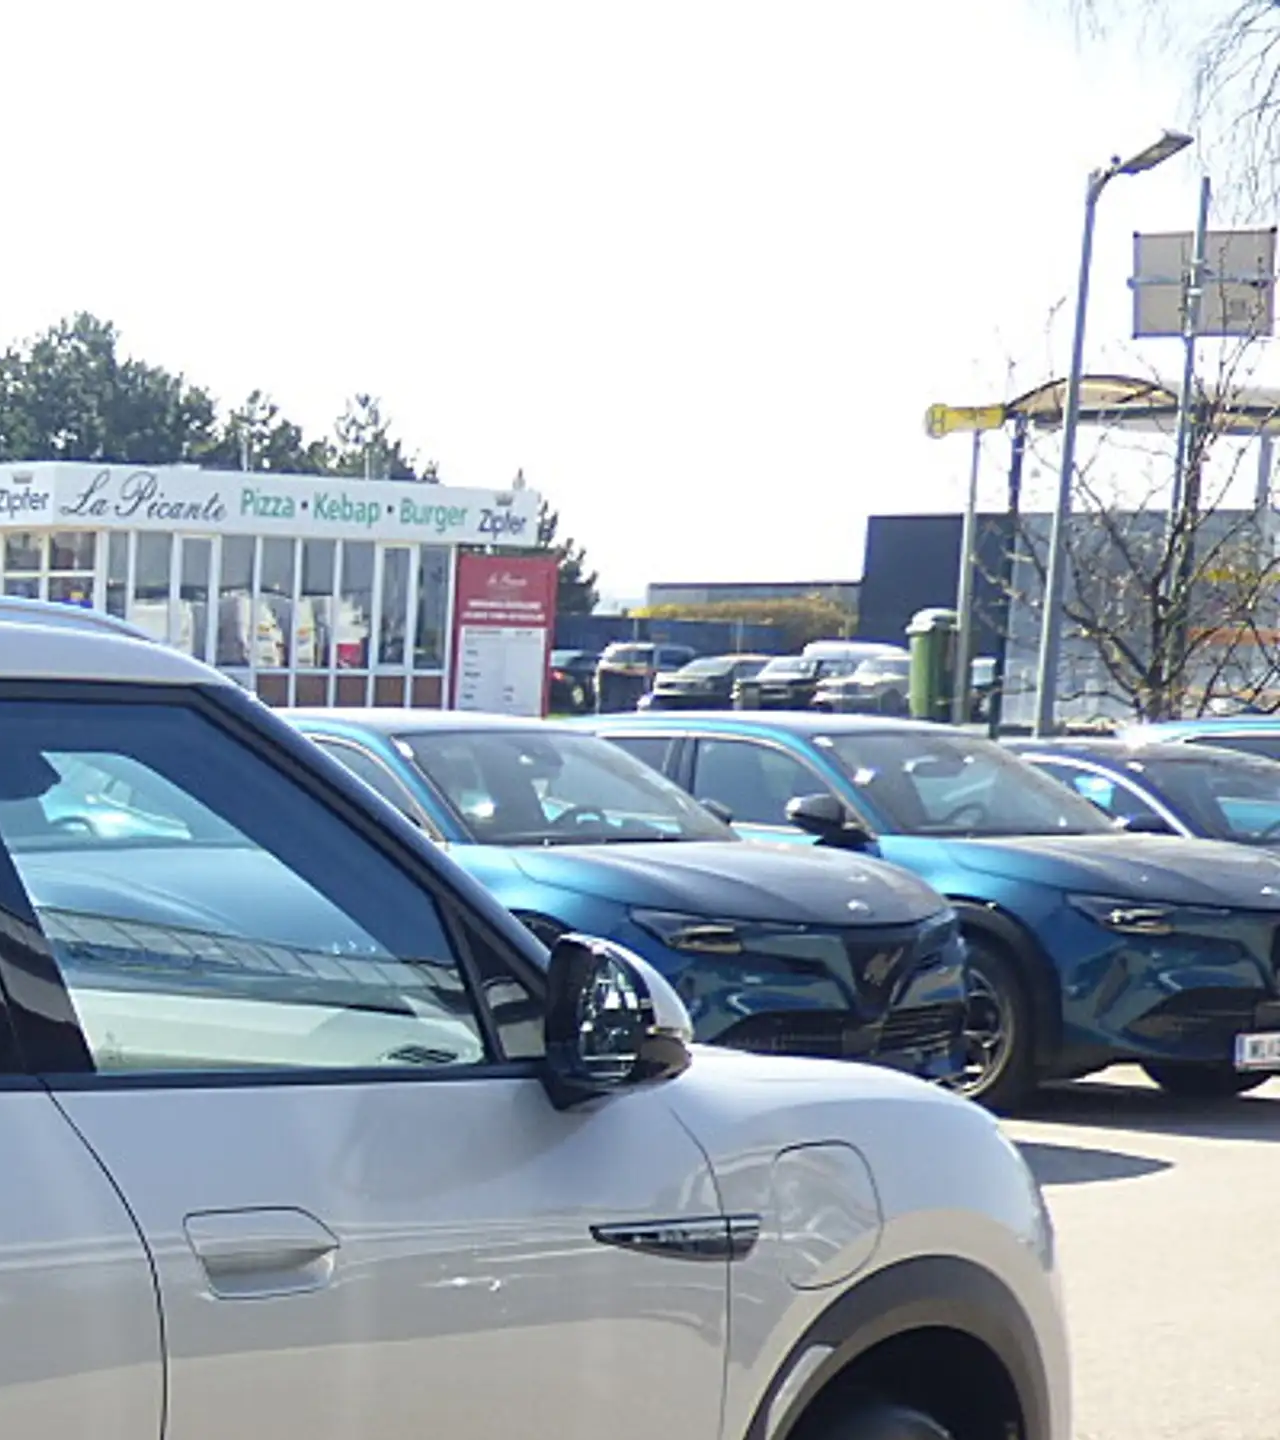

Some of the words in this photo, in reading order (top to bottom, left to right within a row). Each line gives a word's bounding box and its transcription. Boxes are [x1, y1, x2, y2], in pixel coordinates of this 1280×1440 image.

[59, 470, 111, 517] La
[114, 471, 228, 523] Picante
[240, 488, 295, 518] Pizza
[313, 491, 381, 528] Kebap
[399, 497, 468, 532] Burger
